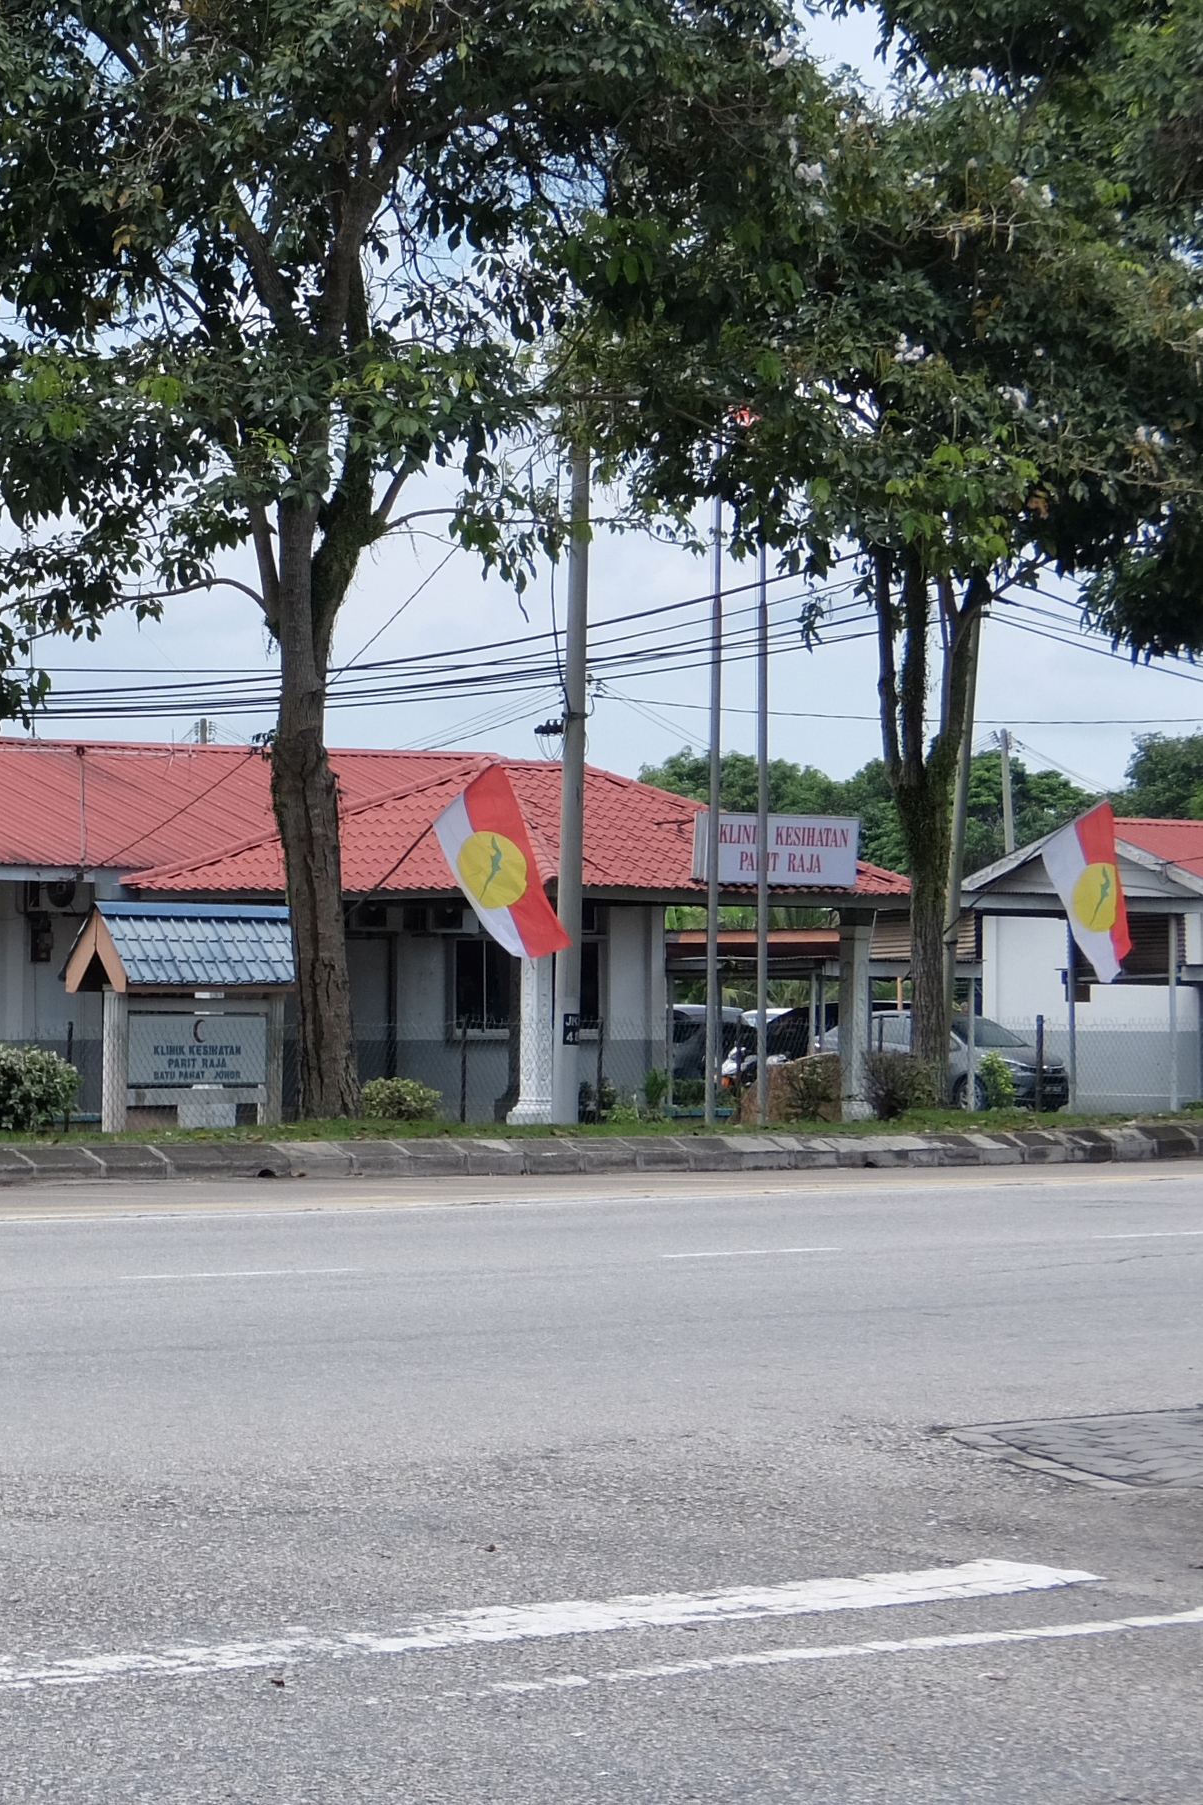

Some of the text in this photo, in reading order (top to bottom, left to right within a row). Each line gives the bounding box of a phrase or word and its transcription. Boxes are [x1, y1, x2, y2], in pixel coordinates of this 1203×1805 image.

[719, 823, 849, 847] KLINI KESIHATAN
[739, 851, 822, 873] PAIT RAJA
[153, 1045, 242, 1056] KLINIK KESIHATAN
[168, 1058, 227, 1069] PARIT RAJA
[153, 1071, 176, 1080] BATU
[214, 1071, 241, 1080] JOHOR
